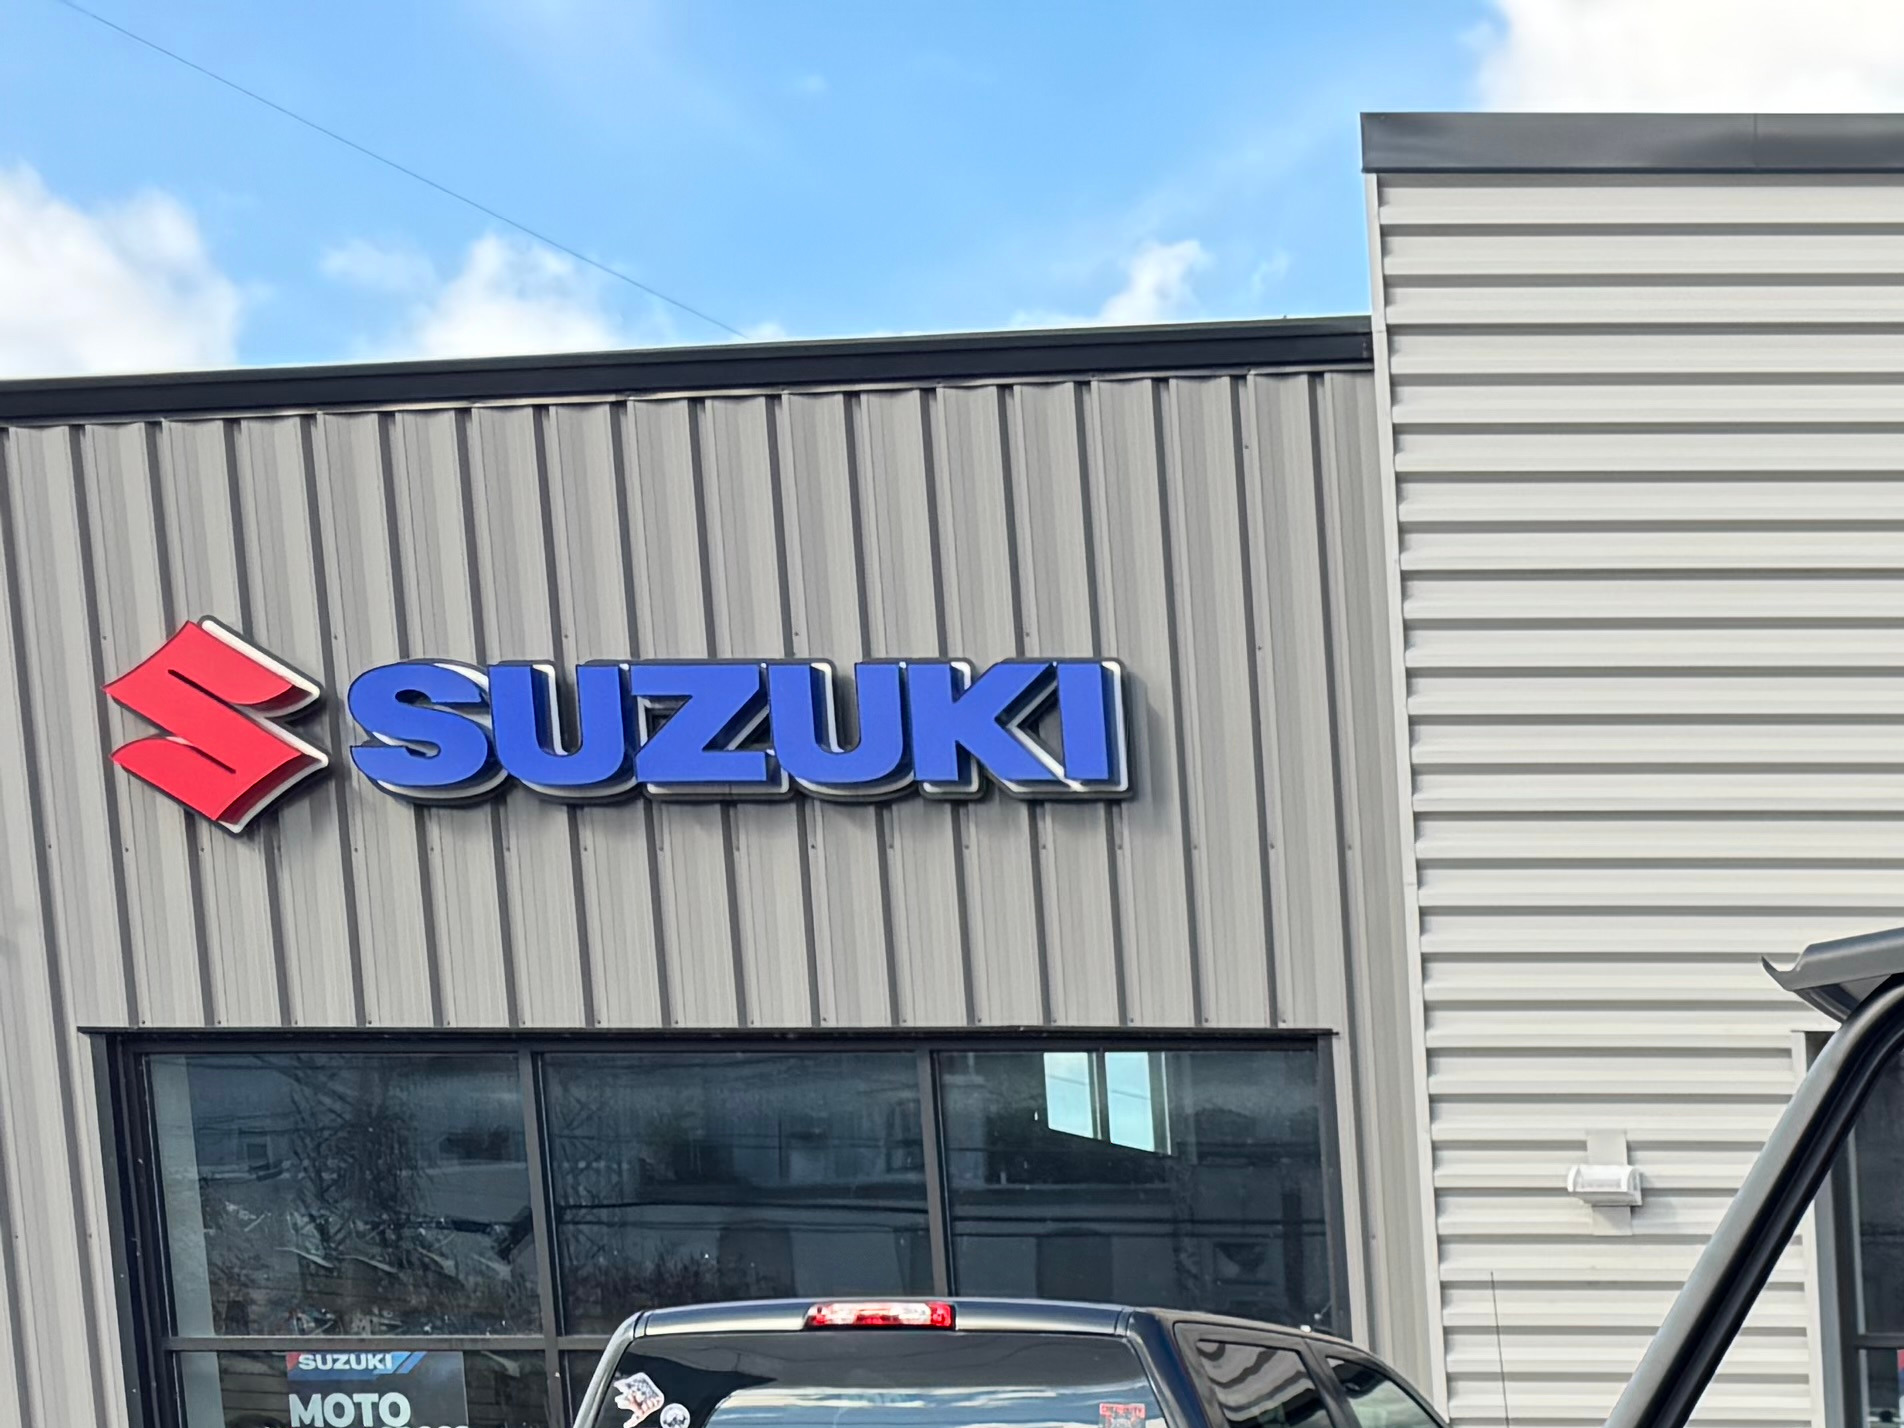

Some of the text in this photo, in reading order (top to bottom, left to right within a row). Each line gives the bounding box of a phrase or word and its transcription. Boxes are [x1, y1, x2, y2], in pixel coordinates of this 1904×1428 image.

[347, 659, 1126, 798] SUZUKI
[299, 1353, 393, 1370] SUZUKI
[289, 1391, 411, 1428] MOTO
